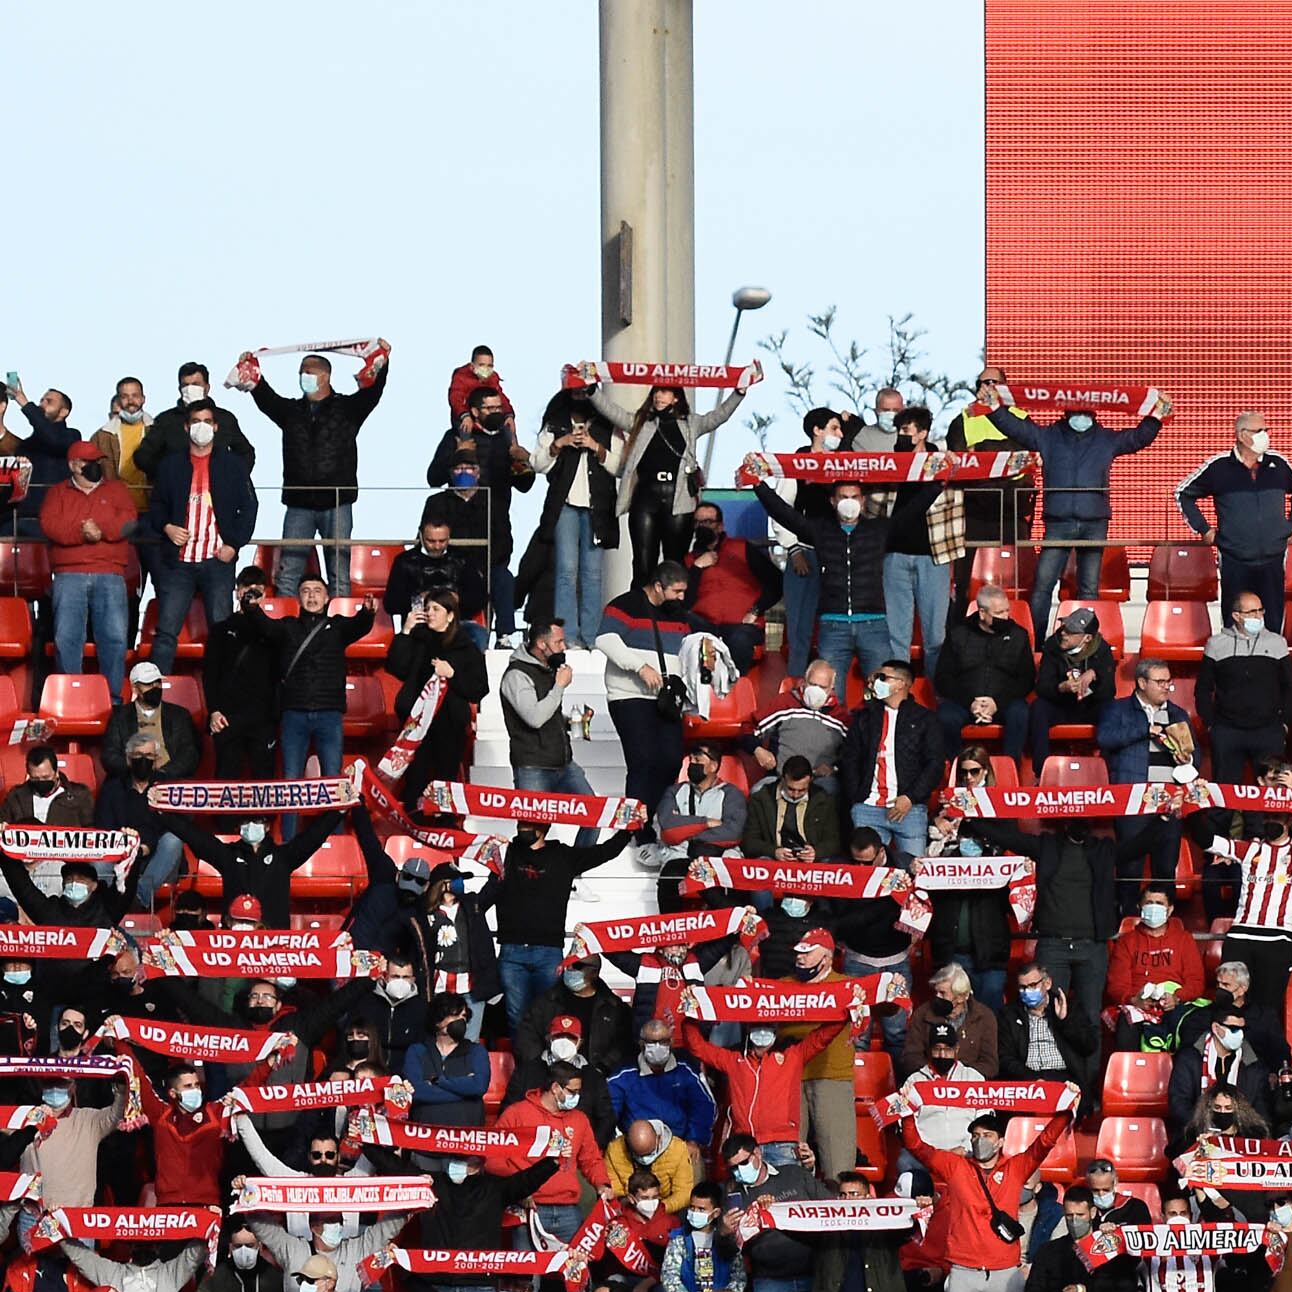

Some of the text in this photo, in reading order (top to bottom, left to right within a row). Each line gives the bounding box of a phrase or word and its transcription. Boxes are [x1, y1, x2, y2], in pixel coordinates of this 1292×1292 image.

[792, 455, 896, 471] UD ALMERÍA
[479, 792, 588, 816] UD ALMERÍA
[1003, 788, 1114, 807] UD ALMERÍA
[511, 810, 558, 821] 2001-2021
[1037, 805, 1084, 815] 2001-2021
[606, 910, 717, 941] UD ALMERÍA
[640, 932, 687, 945] 2001-2021
[724, 991, 836, 1010] UD ALMERÍA
[757, 1008, 806, 1018] 2001-2021
[140, 1027, 249, 1052] UD ALMERÍA
[170, 1045, 218, 1057] 2001-2021
[933, 1082, 1045, 1101] UD ALMERÍA
[966, 1098, 1015, 1108] 2001-2021
[83, 1213, 197, 1229] UD ALMERÍA
[115, 1228, 165, 1236] 2001-2021
[1127, 1230, 1160, 1251] UD
